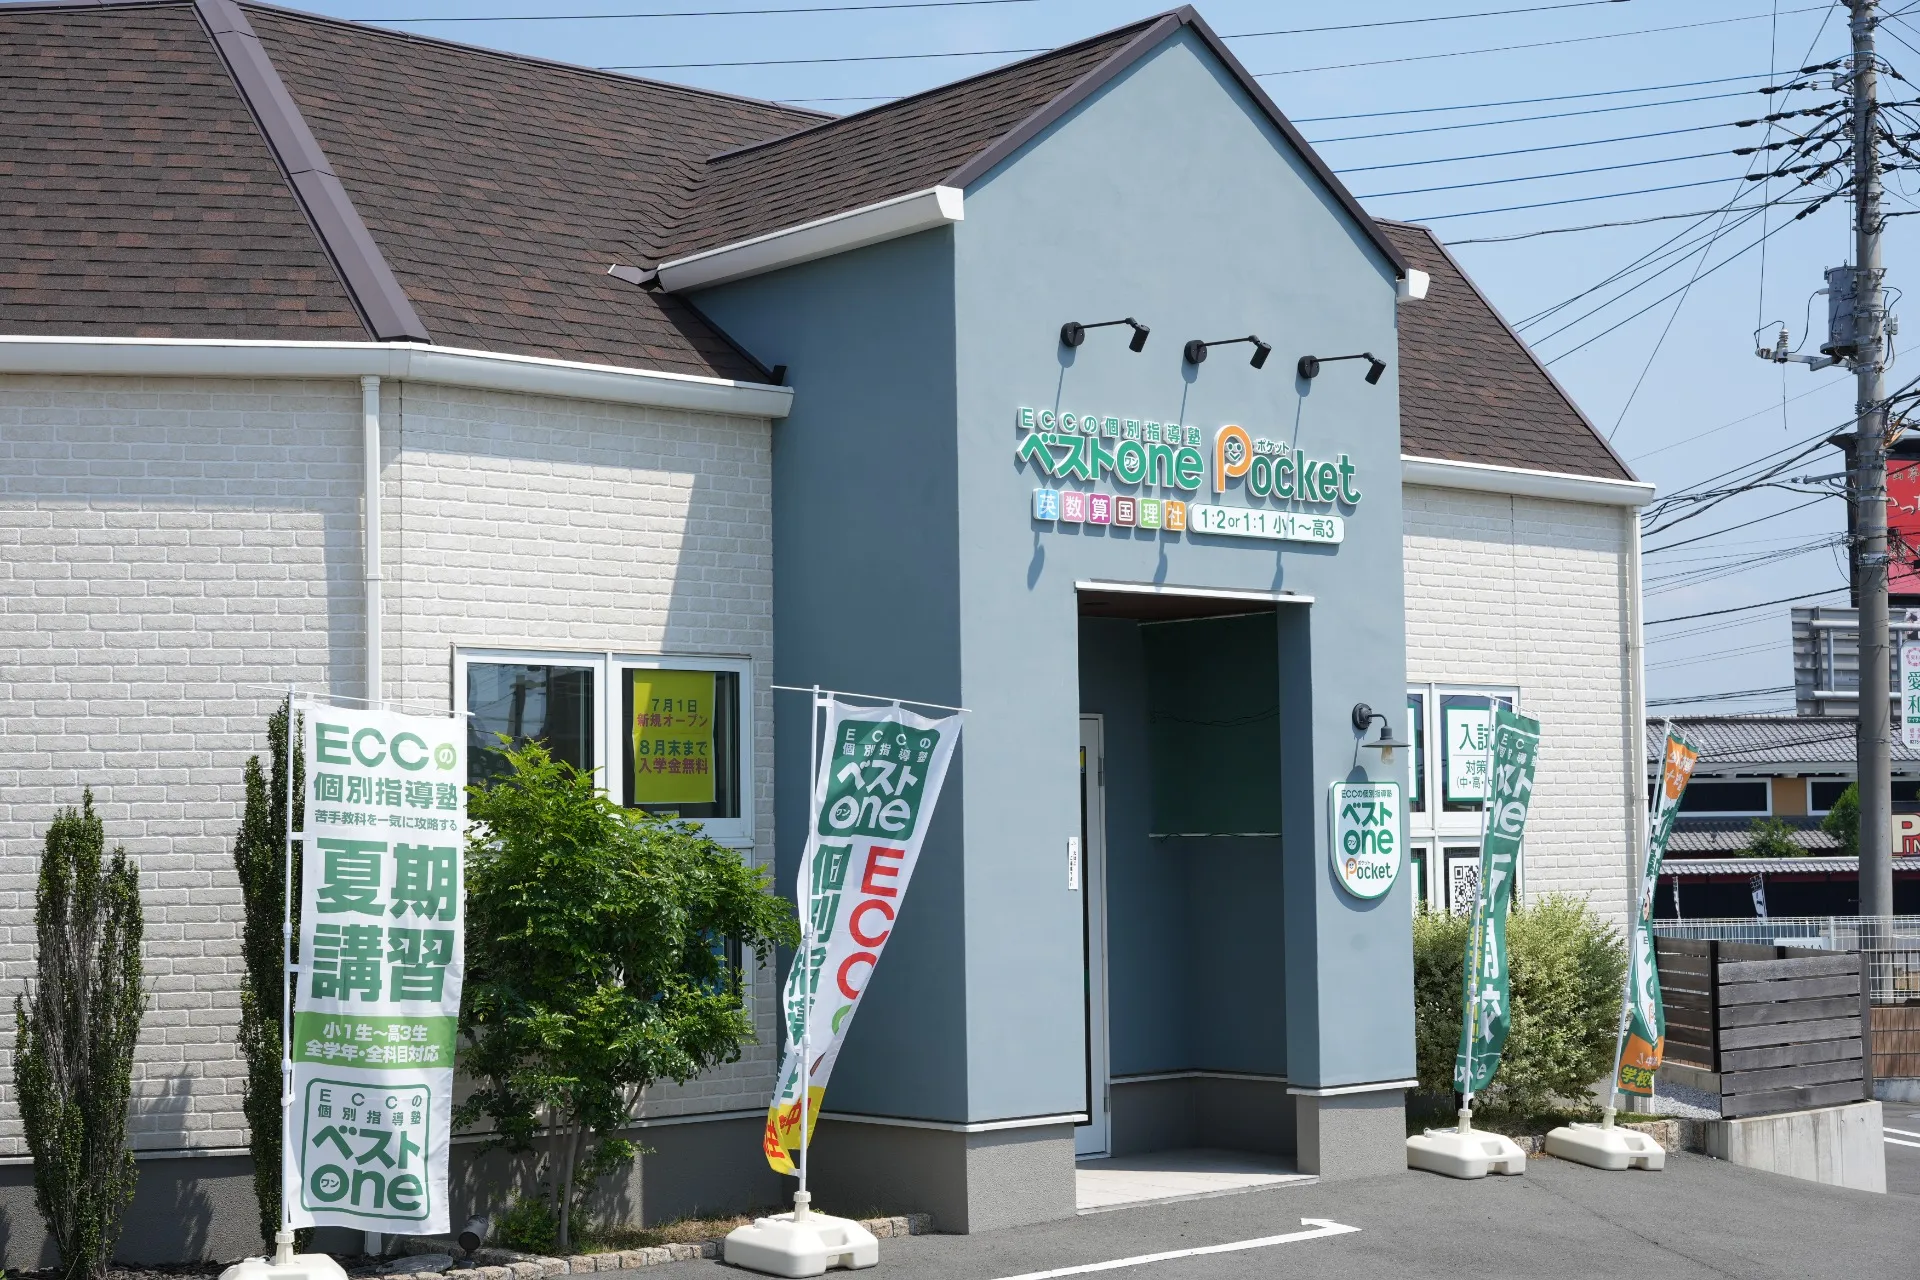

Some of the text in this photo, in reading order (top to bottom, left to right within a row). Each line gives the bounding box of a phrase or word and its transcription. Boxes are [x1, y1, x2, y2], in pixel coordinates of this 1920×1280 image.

[1017, 408, 1201, 447] ECCの個別指導塾
[1256, 439, 1290, 455] ポケット
[1214, 425, 1362, 505] Pocket
[651, 698, 697, 713] 7月1日
[637, 713, 708, 728] 新規オープン
[315, 722, 454, 772] ECCの
[639, 740, 708, 757] 8月末まで
[638, 757, 708, 775] 入学金無料
[836, 759, 918, 796] ベスト
[313, 772, 458, 811] 個別指導塾
[314, 809, 458, 832] 苦手教科を一気に攻略する
[828, 795, 911, 832] one
[1342, 801, 1392, 827] ベスト
[1343, 829, 1393, 855] one
[1345, 857, 1393, 880] Pocket
[304, 1039, 440, 1064] 全学年・全科目対応
[318, 1103, 422, 1126] 個別指導塾
[311, 1124, 421, 1170] ベスト
[310, 1164, 423, 1212] one
